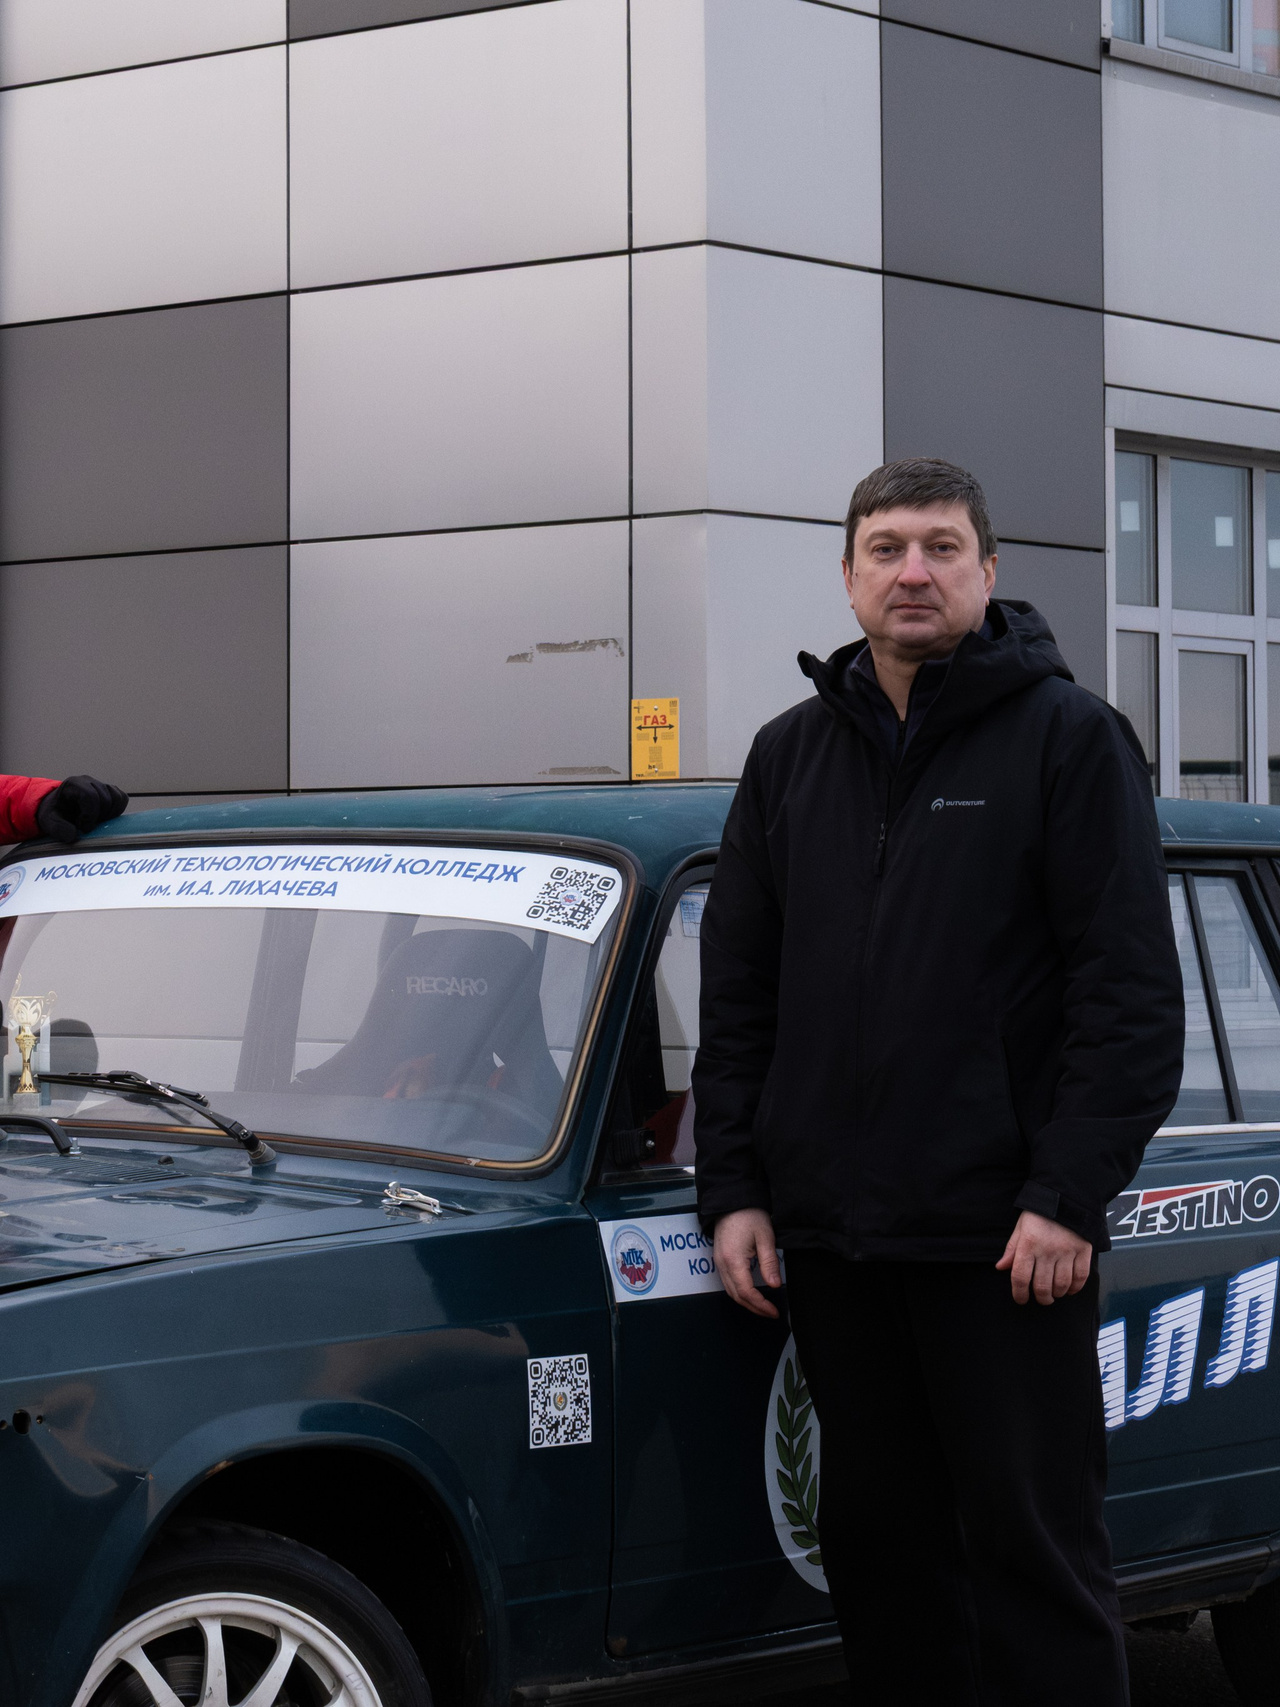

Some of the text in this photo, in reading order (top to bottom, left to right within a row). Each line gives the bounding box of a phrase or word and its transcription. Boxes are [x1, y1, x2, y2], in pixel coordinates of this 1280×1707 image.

[643, 715, 667, 725] ГАЗ
[34, 854, 527, 883] МОСКОВСКИЙ ТЕХНОЛОГИЧЕСКИЙ КОЛЛЕДЖ
[176, 880, 214, 896] И.А.
[218, 880, 338, 897] ЛИХАЧЕВА
[406, 976, 488, 997] RECARO
[1106, 1175, 1280, 1240] ZESTINO
[620, 1248, 646, 1266] МТК
